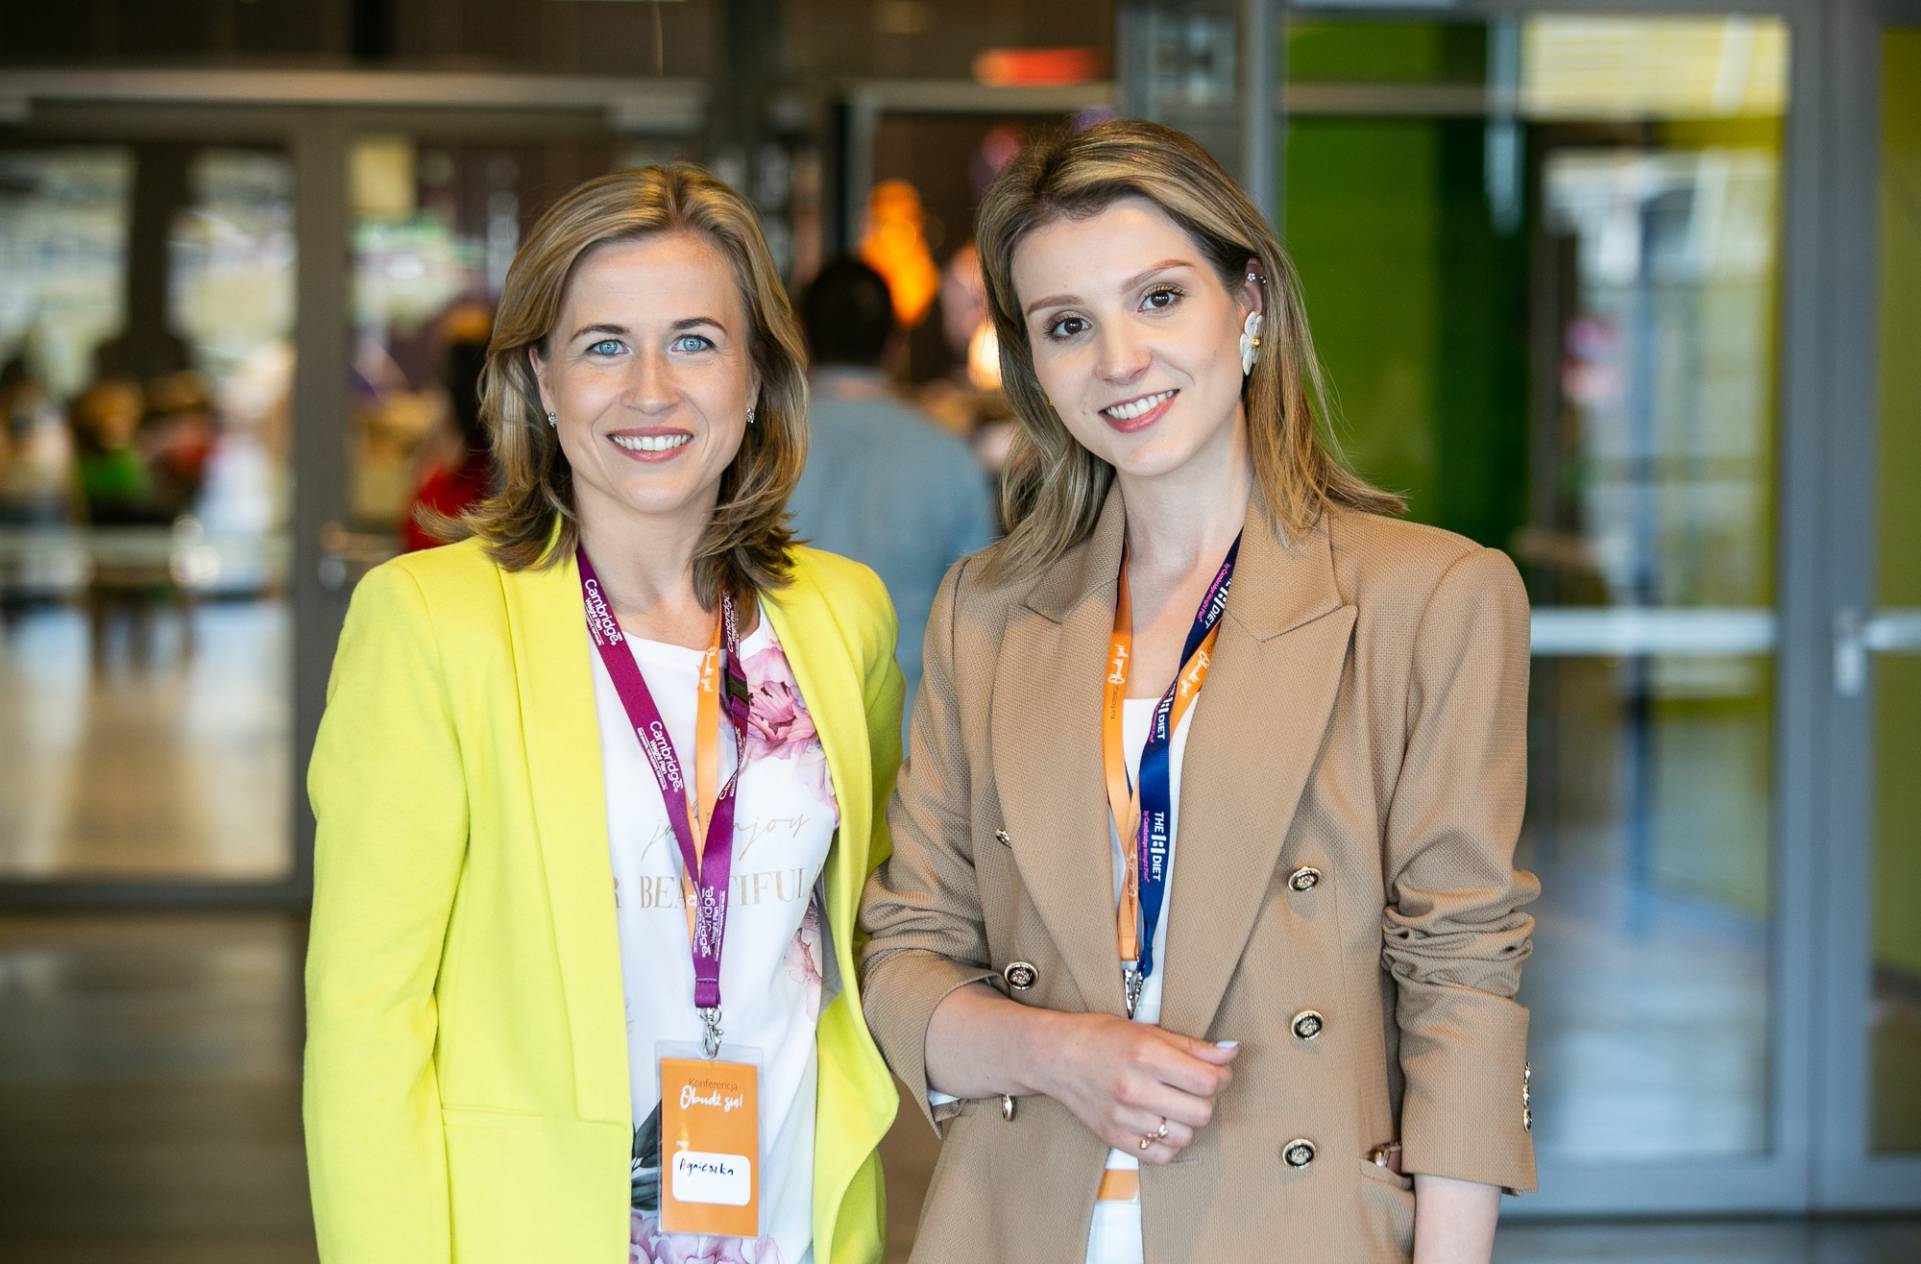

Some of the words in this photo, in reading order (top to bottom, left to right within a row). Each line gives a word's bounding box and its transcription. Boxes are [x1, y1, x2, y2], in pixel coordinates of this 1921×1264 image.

[583, 577, 624, 647] Cambridge
[1203, 604, 1221, 630] DIET
[1157, 714, 1166, 740] DIET
[648, 718, 686, 793] Cambridge
[1154, 811, 1164, 833] THE
[1150, 834, 1167, 854] 1:1
[1152, 855, 1162, 882] DIET
